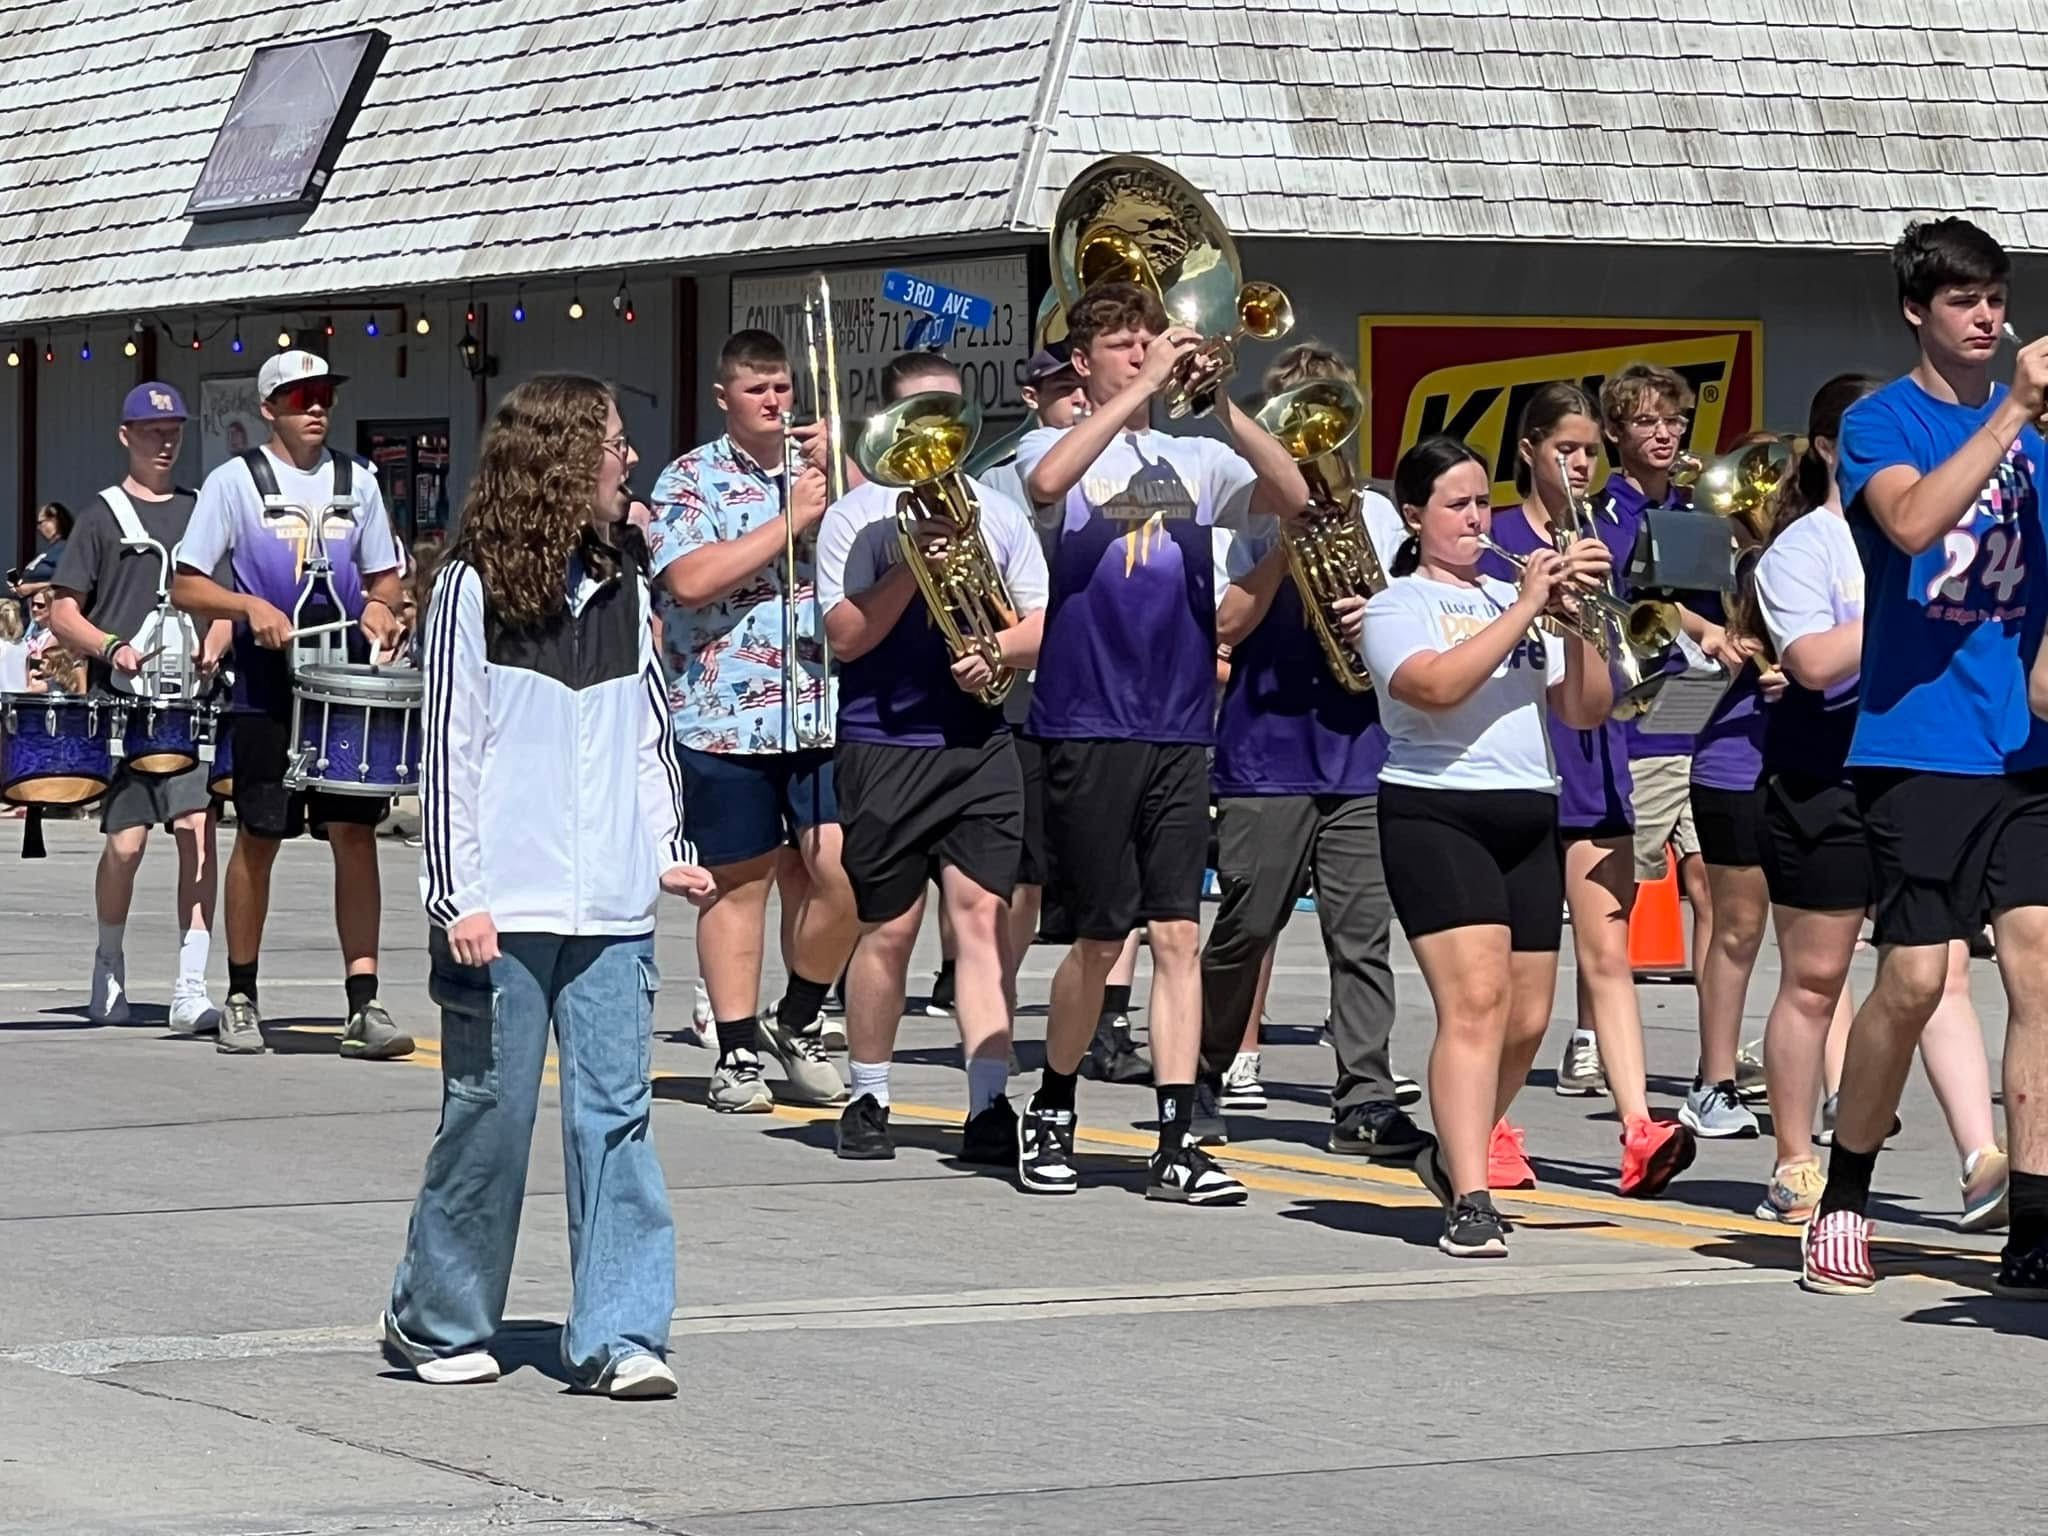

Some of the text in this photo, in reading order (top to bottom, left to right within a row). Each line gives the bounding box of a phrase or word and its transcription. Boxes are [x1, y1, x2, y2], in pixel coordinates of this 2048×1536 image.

[903, 279, 935, 308] 3RD
[942, 292, 973, 320] AVE
[1926, 528, 2025, 602] 24
